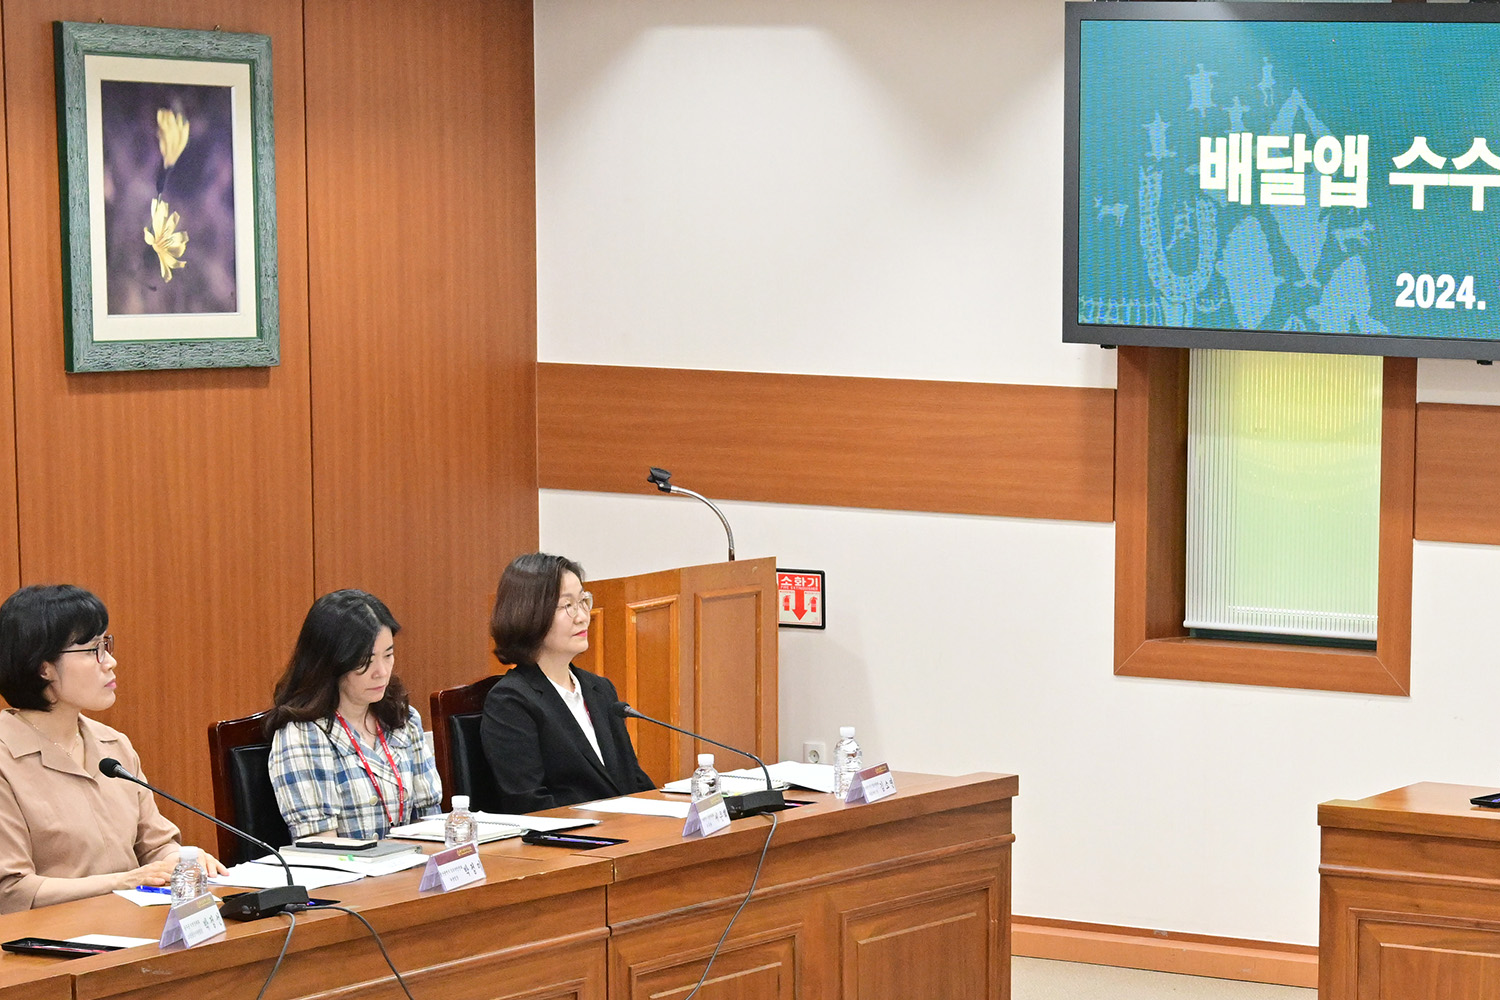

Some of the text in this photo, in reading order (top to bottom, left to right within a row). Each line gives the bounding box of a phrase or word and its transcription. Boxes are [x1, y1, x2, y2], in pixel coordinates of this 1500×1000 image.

[1199, 132, 1370, 209] 배달앱
[1395, 272, 1486, 311] 2024.
[780, 575, 819, 588] 소화기
